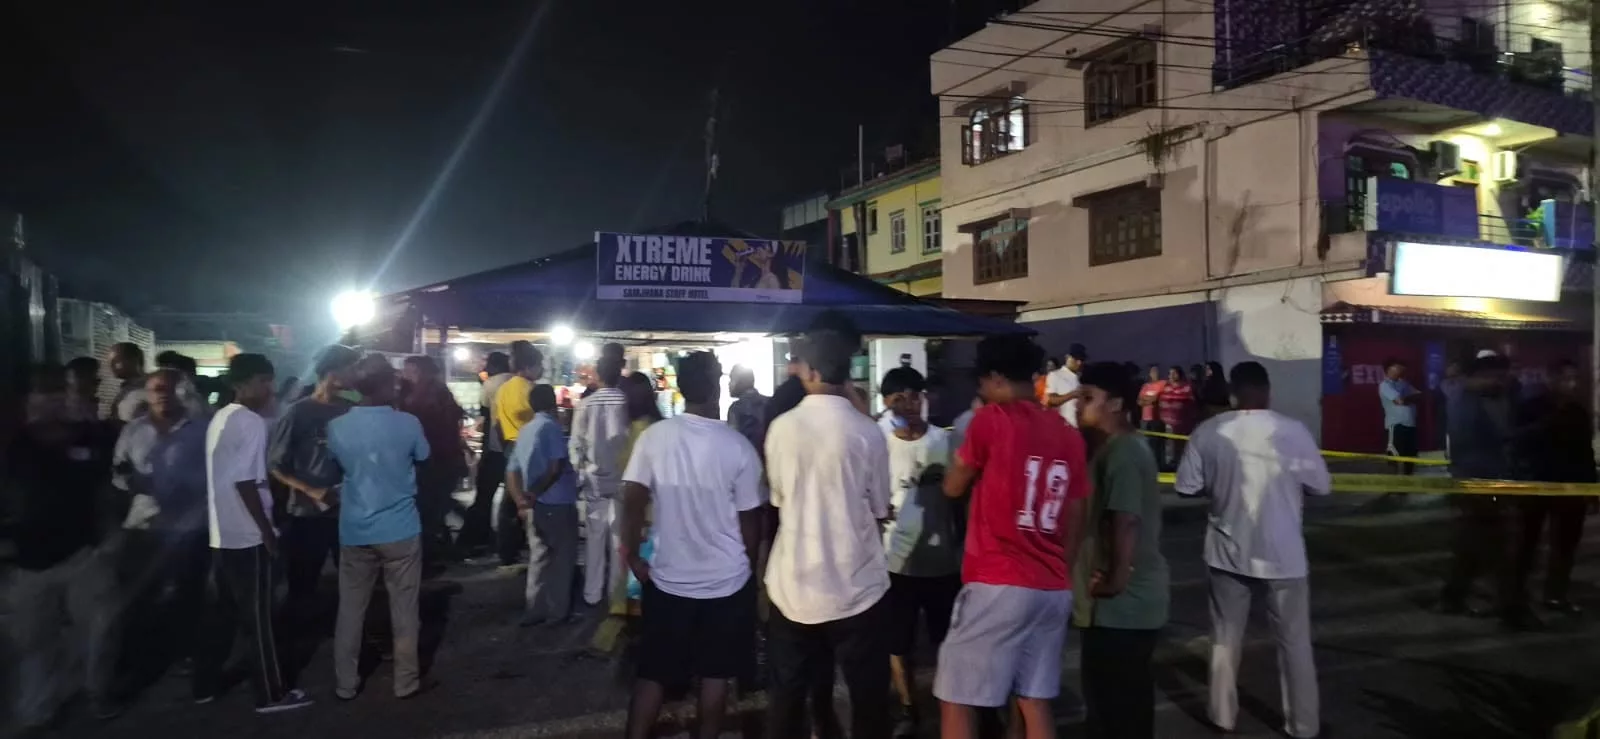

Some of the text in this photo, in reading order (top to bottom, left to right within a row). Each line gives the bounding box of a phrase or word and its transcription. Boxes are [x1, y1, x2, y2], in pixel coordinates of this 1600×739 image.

[1378, 187, 1436, 219] apollo
[616, 235, 712, 264] XTREME
[615, 265, 711, 281] ENERGY DRINK
